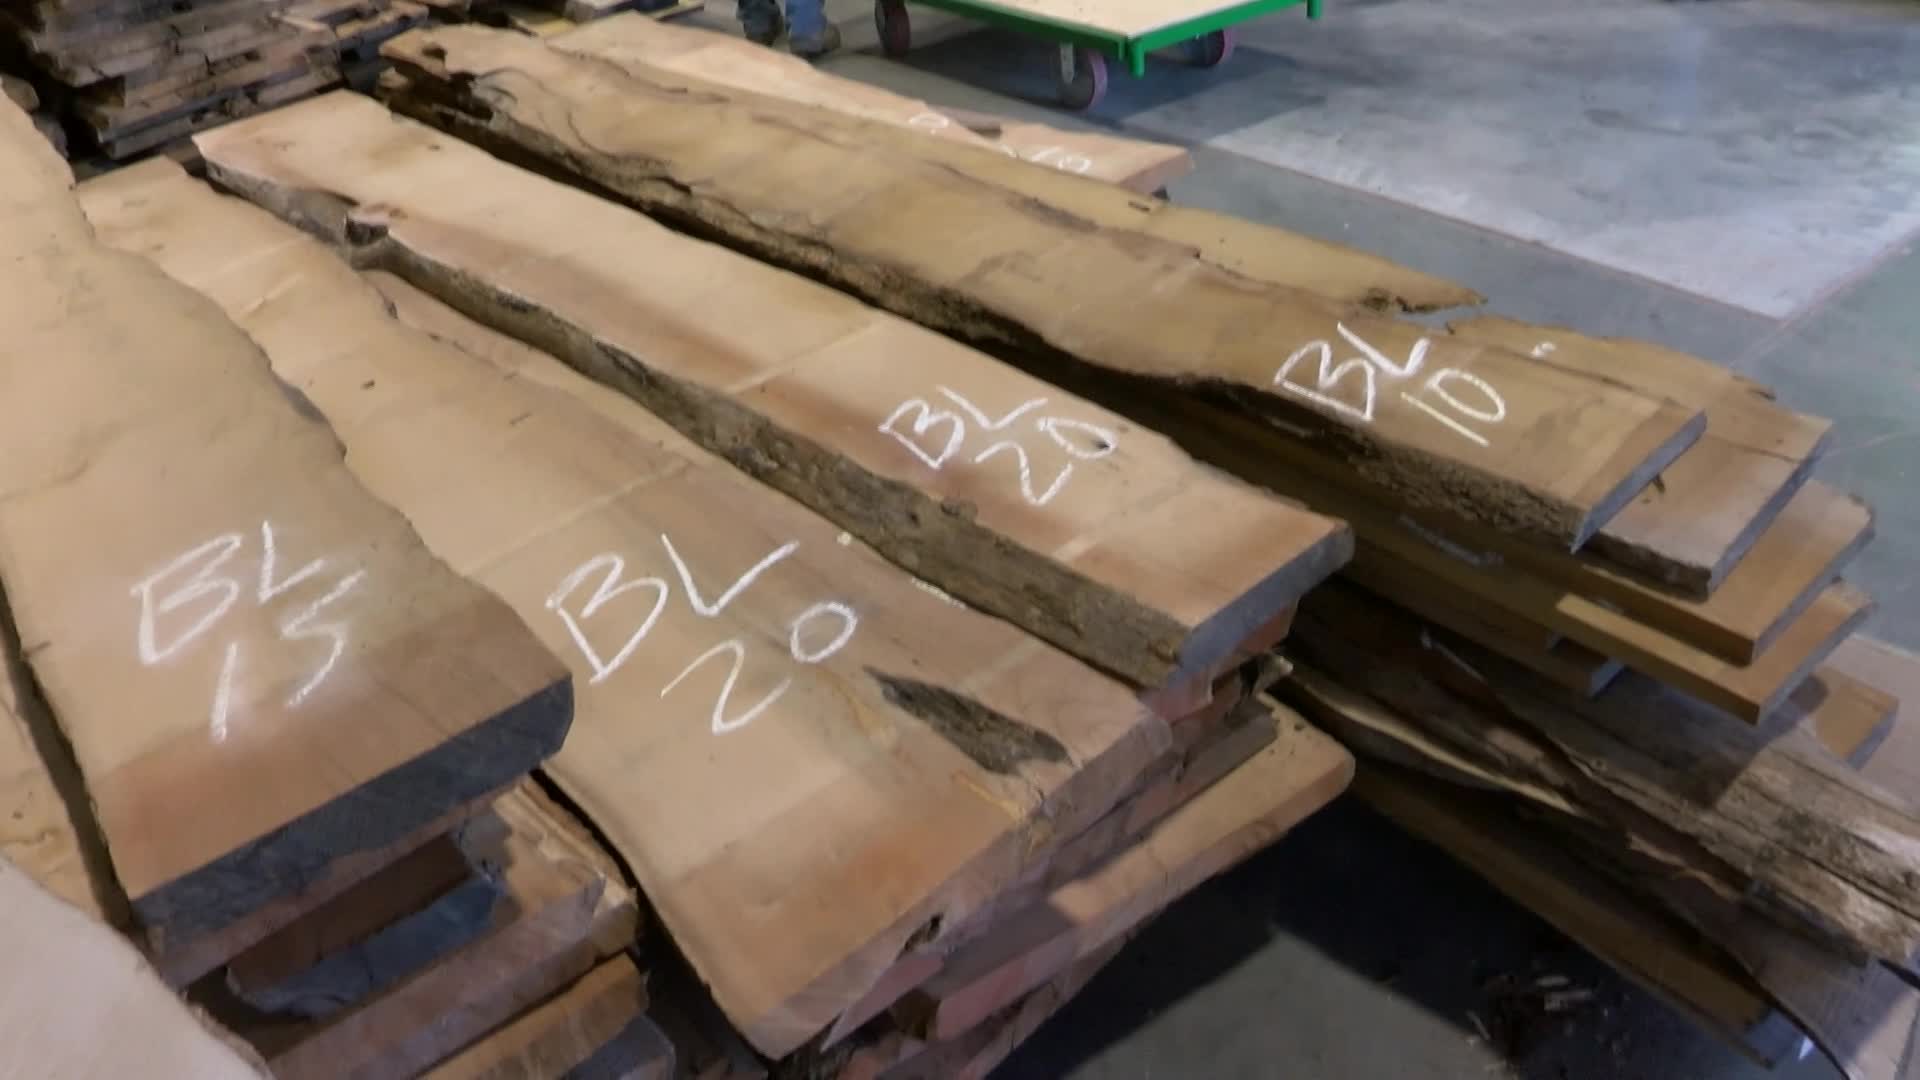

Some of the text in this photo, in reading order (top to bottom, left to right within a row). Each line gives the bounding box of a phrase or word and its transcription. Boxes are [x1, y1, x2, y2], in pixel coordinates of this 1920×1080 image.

[878, 384, 1048, 469] BL
[1274, 320, 1430, 421] BL
[1400, 367, 1506, 446] 10
[971, 416, 1117, 506] 20
[130, 519, 325, 666] BL
[545, 532, 799, 684] BL
[210, 568, 366, 742] 15
[660, 601, 858, 735] 20
